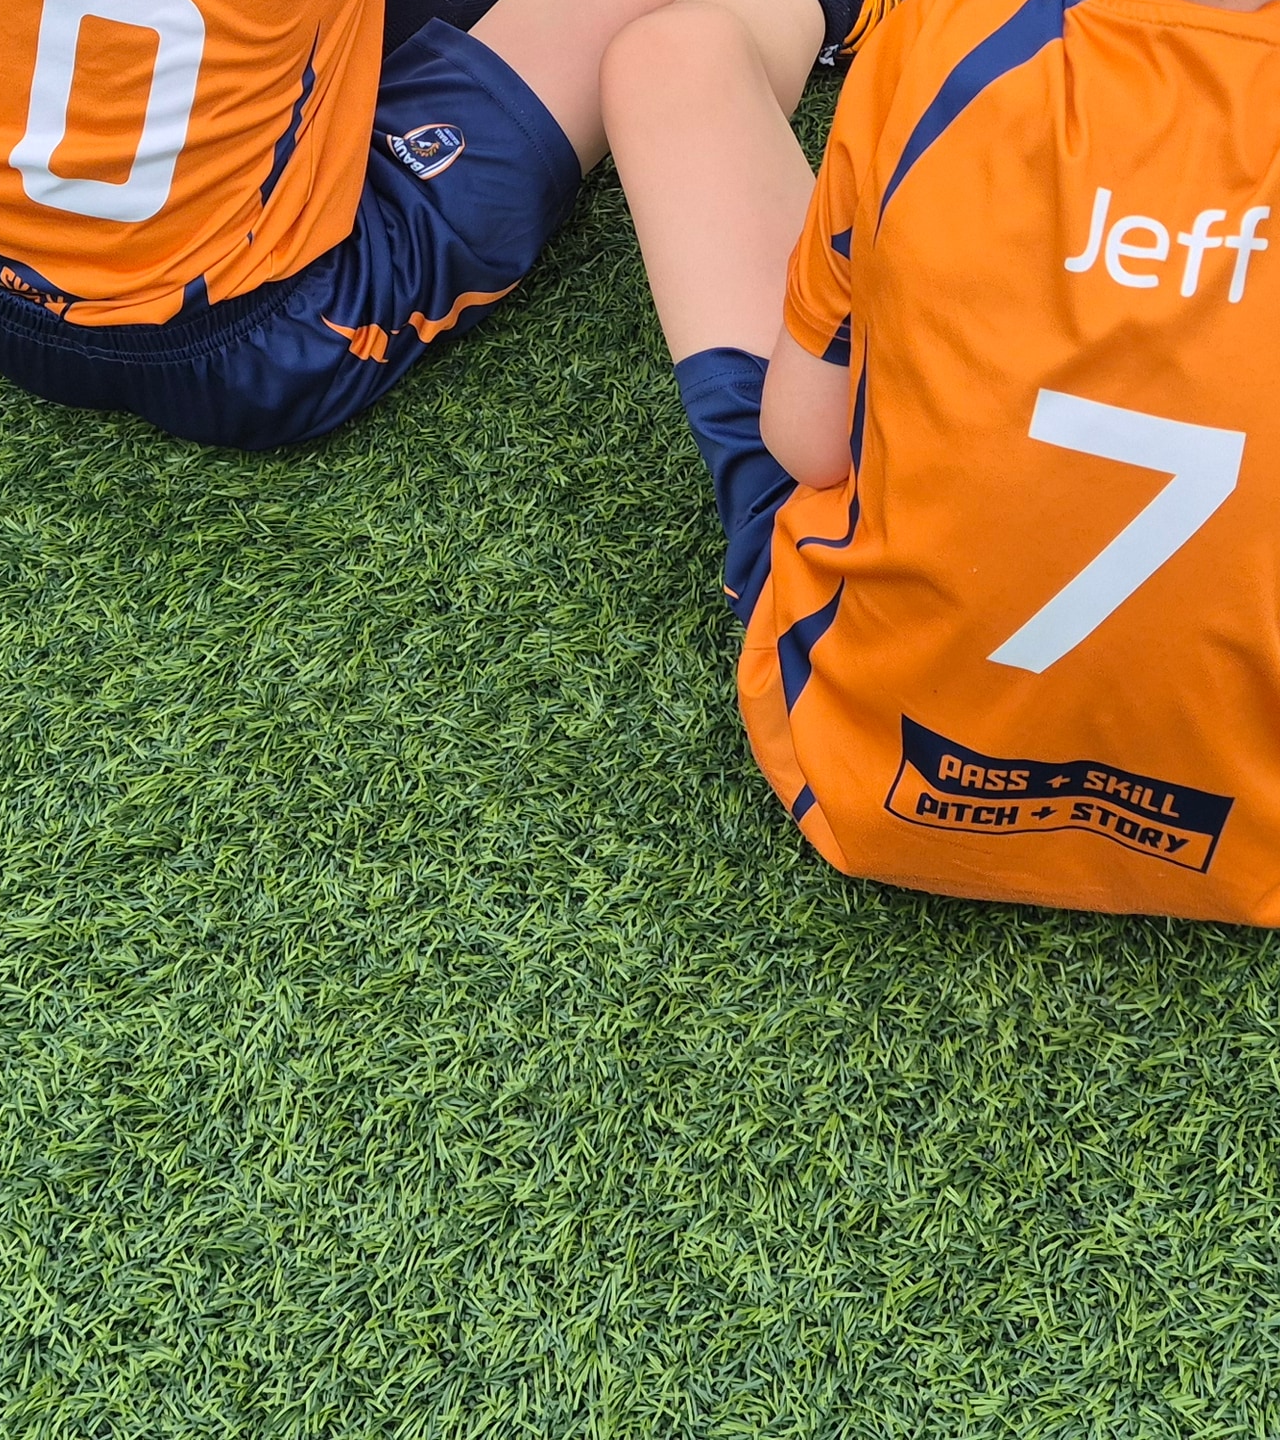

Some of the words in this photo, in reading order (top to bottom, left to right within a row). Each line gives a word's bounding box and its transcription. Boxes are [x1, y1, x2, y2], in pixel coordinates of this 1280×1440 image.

[1063, 186, 1271, 304] Jeff
[985, 387, 1247, 675] 7
[937, 753, 1031, 792] PASS
[1069, 802, 1191, 853] STORY
